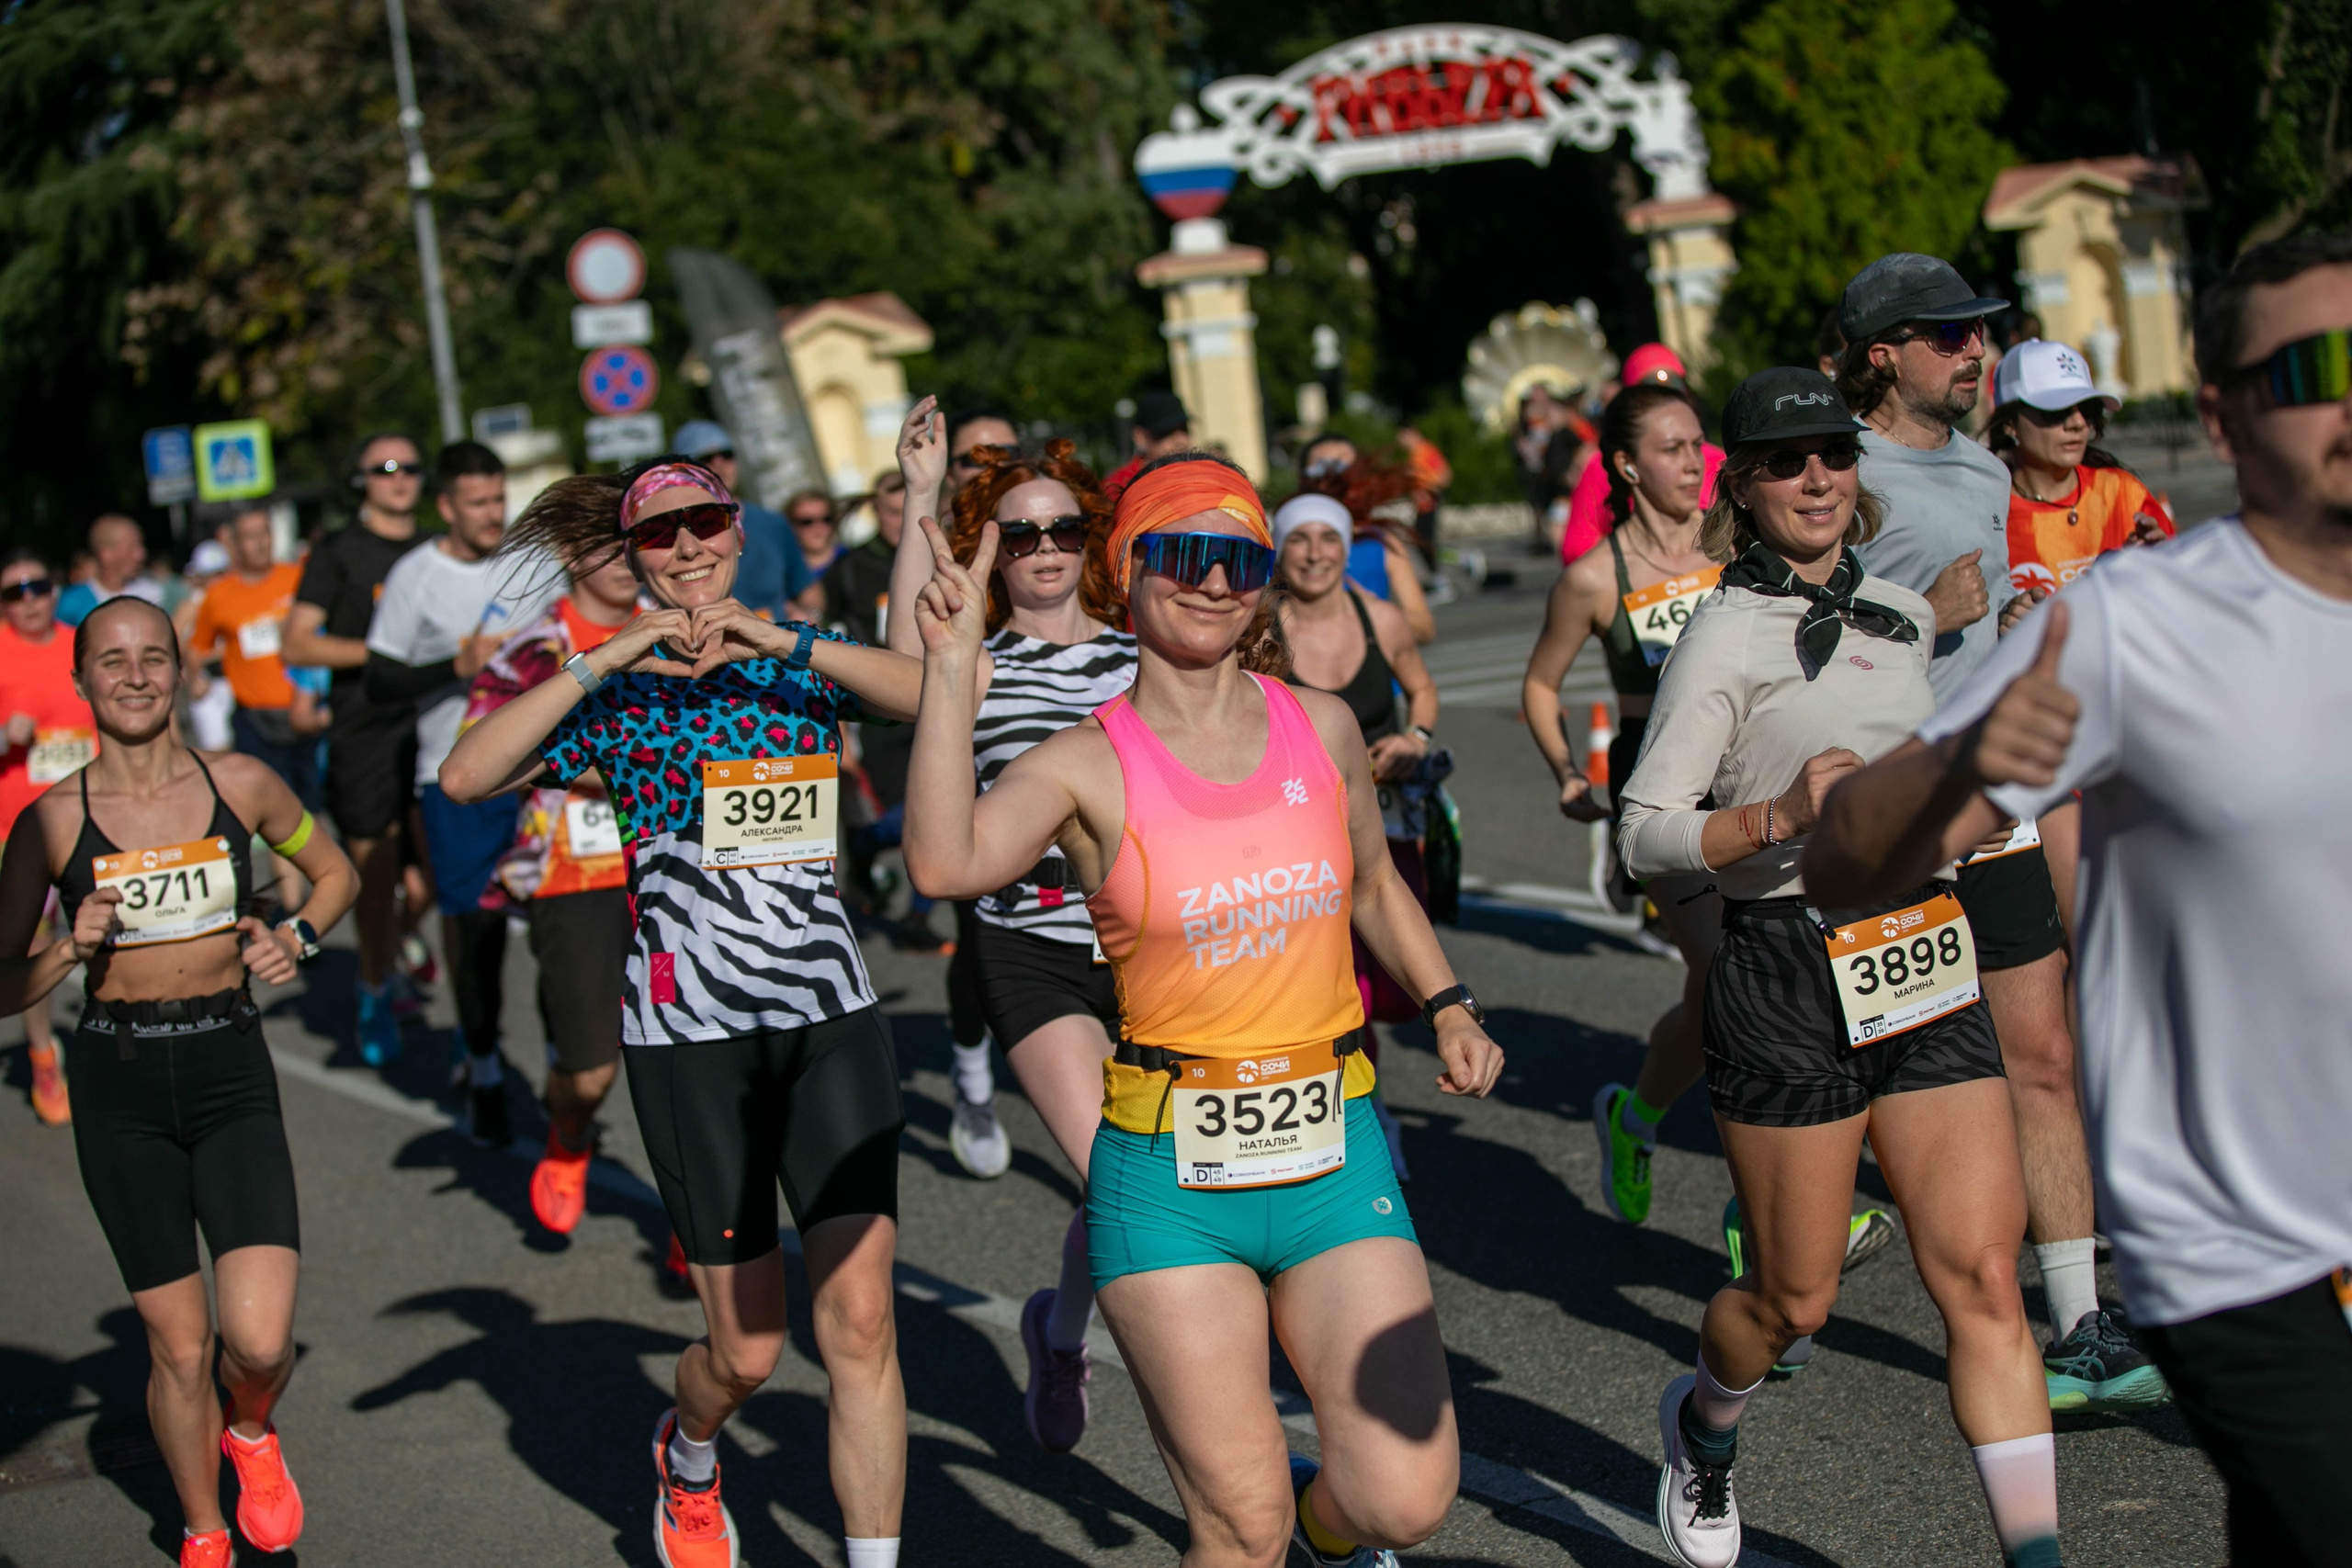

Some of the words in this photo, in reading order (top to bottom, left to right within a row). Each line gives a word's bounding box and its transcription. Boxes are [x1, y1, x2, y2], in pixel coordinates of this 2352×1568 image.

[719, 769, 729, 778] 10
[723, 784, 818, 827] 3921
[741, 825, 803, 837] АЛЕКСАНДРА
[717, 853, 726, 864] C
[123, 867, 209, 910] 3711
[1177, 860, 1339, 919] ZANOZA
[155, 907, 186, 918] ОЛЬГА
[1182, 888, 1343, 944] RUNNING
[1900, 912, 1924, 925] СОЧИ
[1843, 933, 1855, 944] 10
[1187, 928, 1287, 970] TEAM
[1849, 926, 1962, 996] 3898
[1894, 978, 1935, 999] МАРИНА
[1863, 1025, 1873, 1038] D
[1192, 1067, 1205, 1078] 10
[1261, 1060, 1290, 1072] СОЧИ
[1194, 1080, 1329, 1137] 3523
[1238, 1134, 1297, 1150] НАТАЛЬЯ
[1235, 1150, 1260, 1158] ZANOZA
[1260, 1148, 1286, 1156] RUNNING
[1196, 1169, 1208, 1182] D
